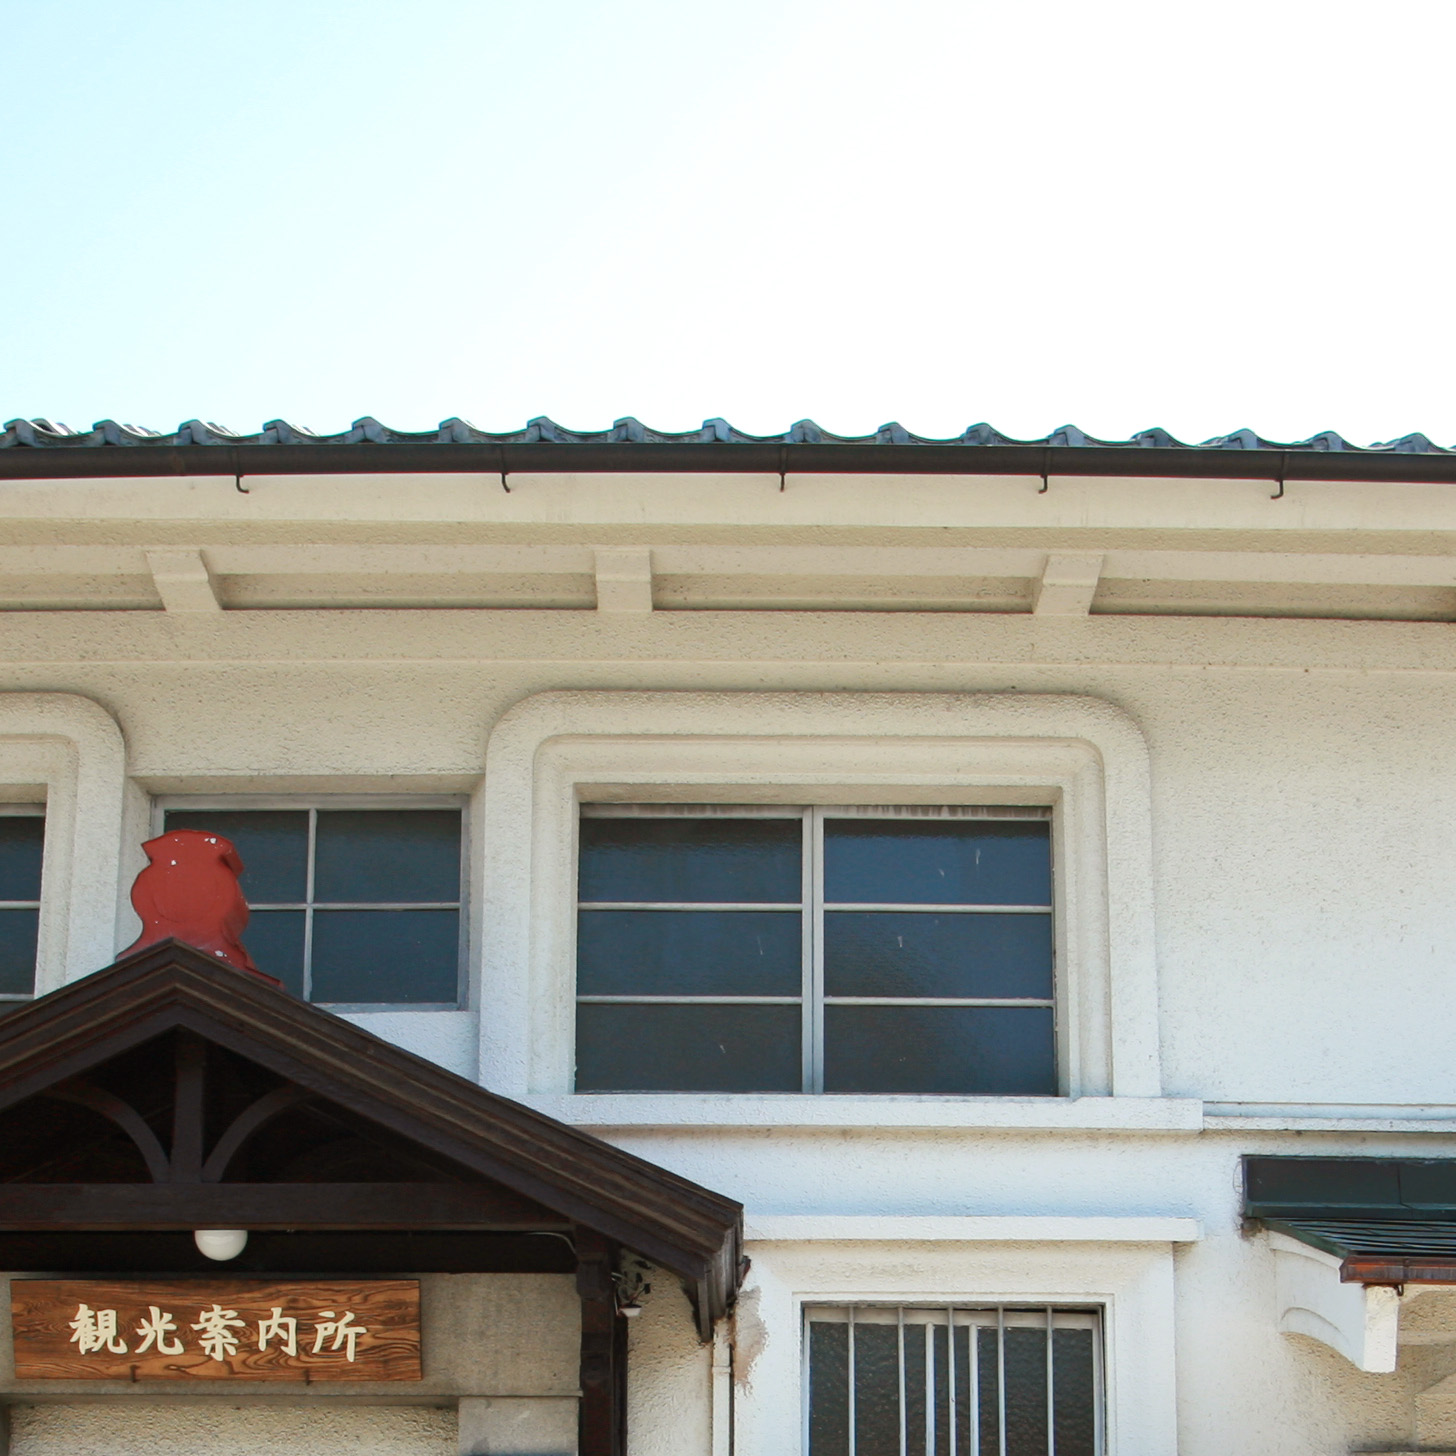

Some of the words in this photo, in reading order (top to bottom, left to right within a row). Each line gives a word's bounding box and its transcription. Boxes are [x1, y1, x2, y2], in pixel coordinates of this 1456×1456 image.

[68, 1303, 368, 1363] 観光案内所
